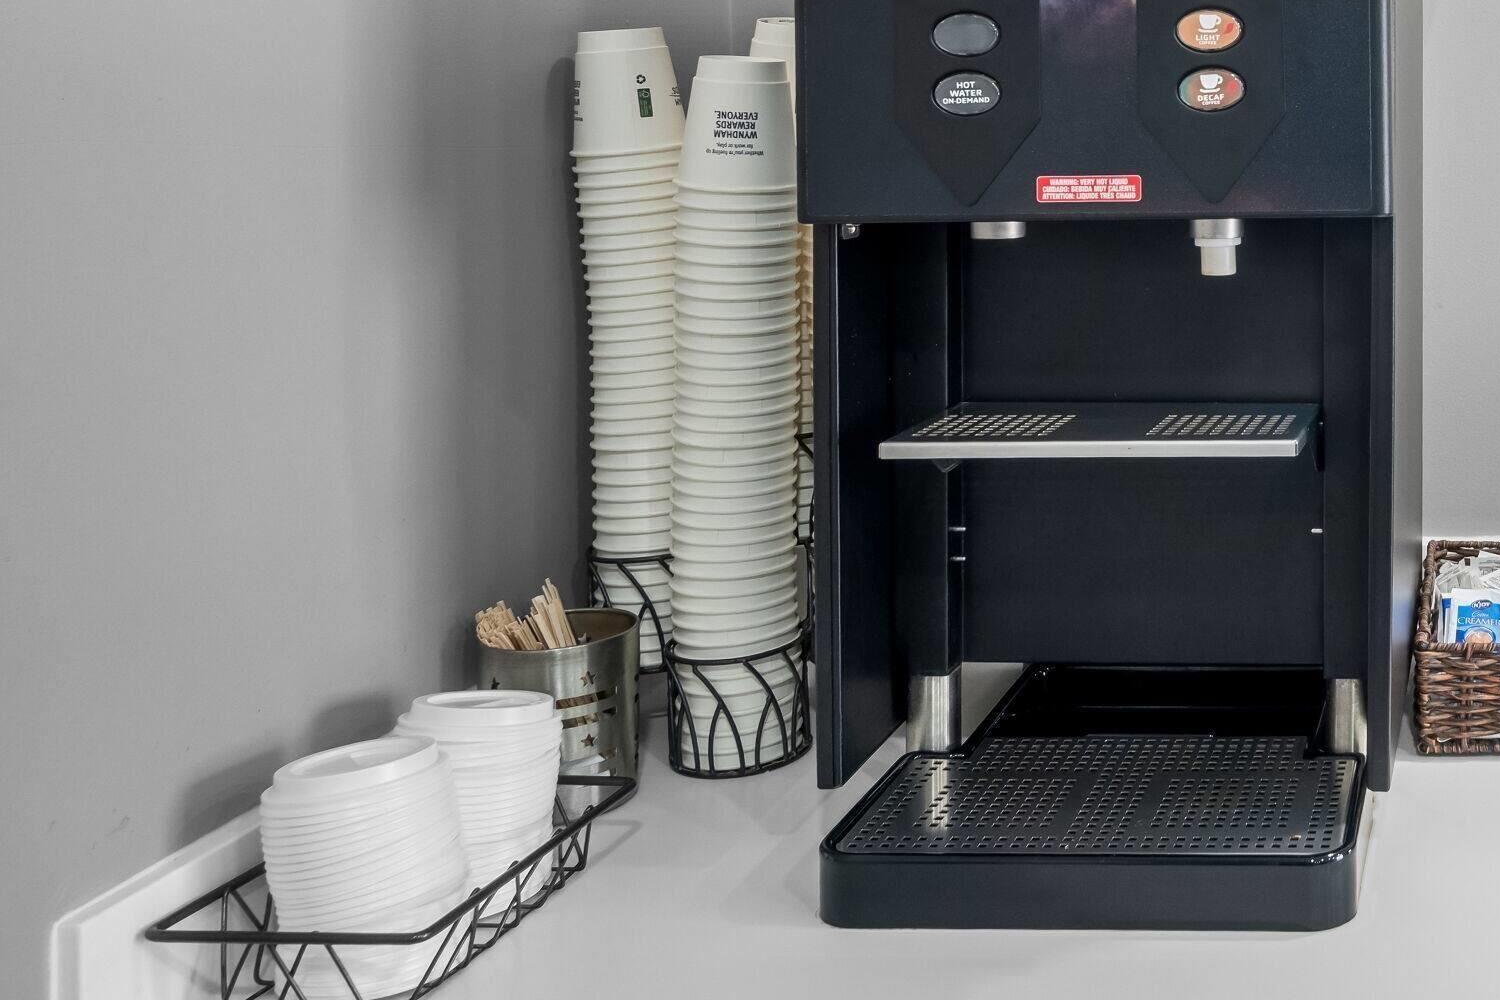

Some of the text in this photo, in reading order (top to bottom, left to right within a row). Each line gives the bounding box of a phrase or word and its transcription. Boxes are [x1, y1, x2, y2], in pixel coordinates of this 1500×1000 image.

[956, 81, 975, 89] HOT
[949, 89, 982, 98] WATER
[1197, 94, 1225, 102] DECAF
[942, 96, 990, 105] ON-DEMAND
[715, 120, 756, 130] REWARDS
[713, 129, 758, 139] WYNDHAM
[1049, 177, 1129, 186] WARNING: VERY HOT LIQUID
